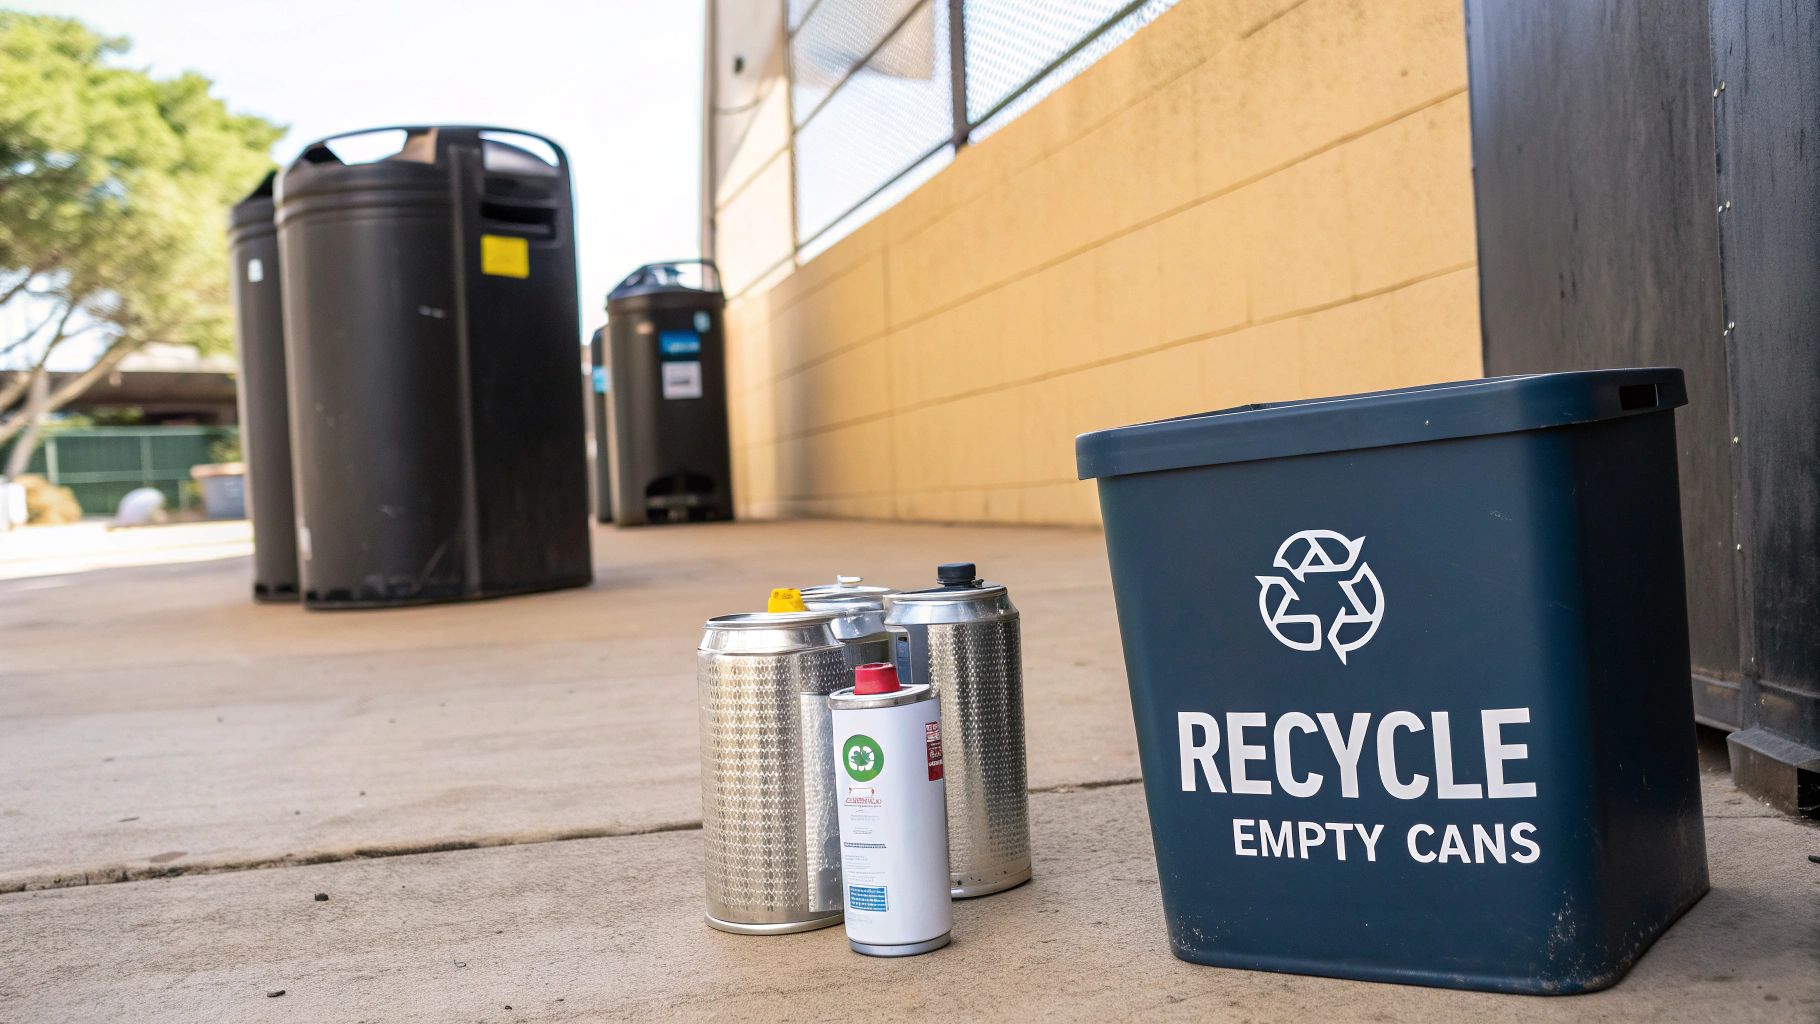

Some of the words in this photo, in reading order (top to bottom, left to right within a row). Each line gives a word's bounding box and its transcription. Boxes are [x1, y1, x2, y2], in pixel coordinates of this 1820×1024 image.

[1178, 708, 1537, 799] RECYCLE
[1233, 819, 1385, 862] EMPTY
[1407, 822, 1541, 864] CANS
